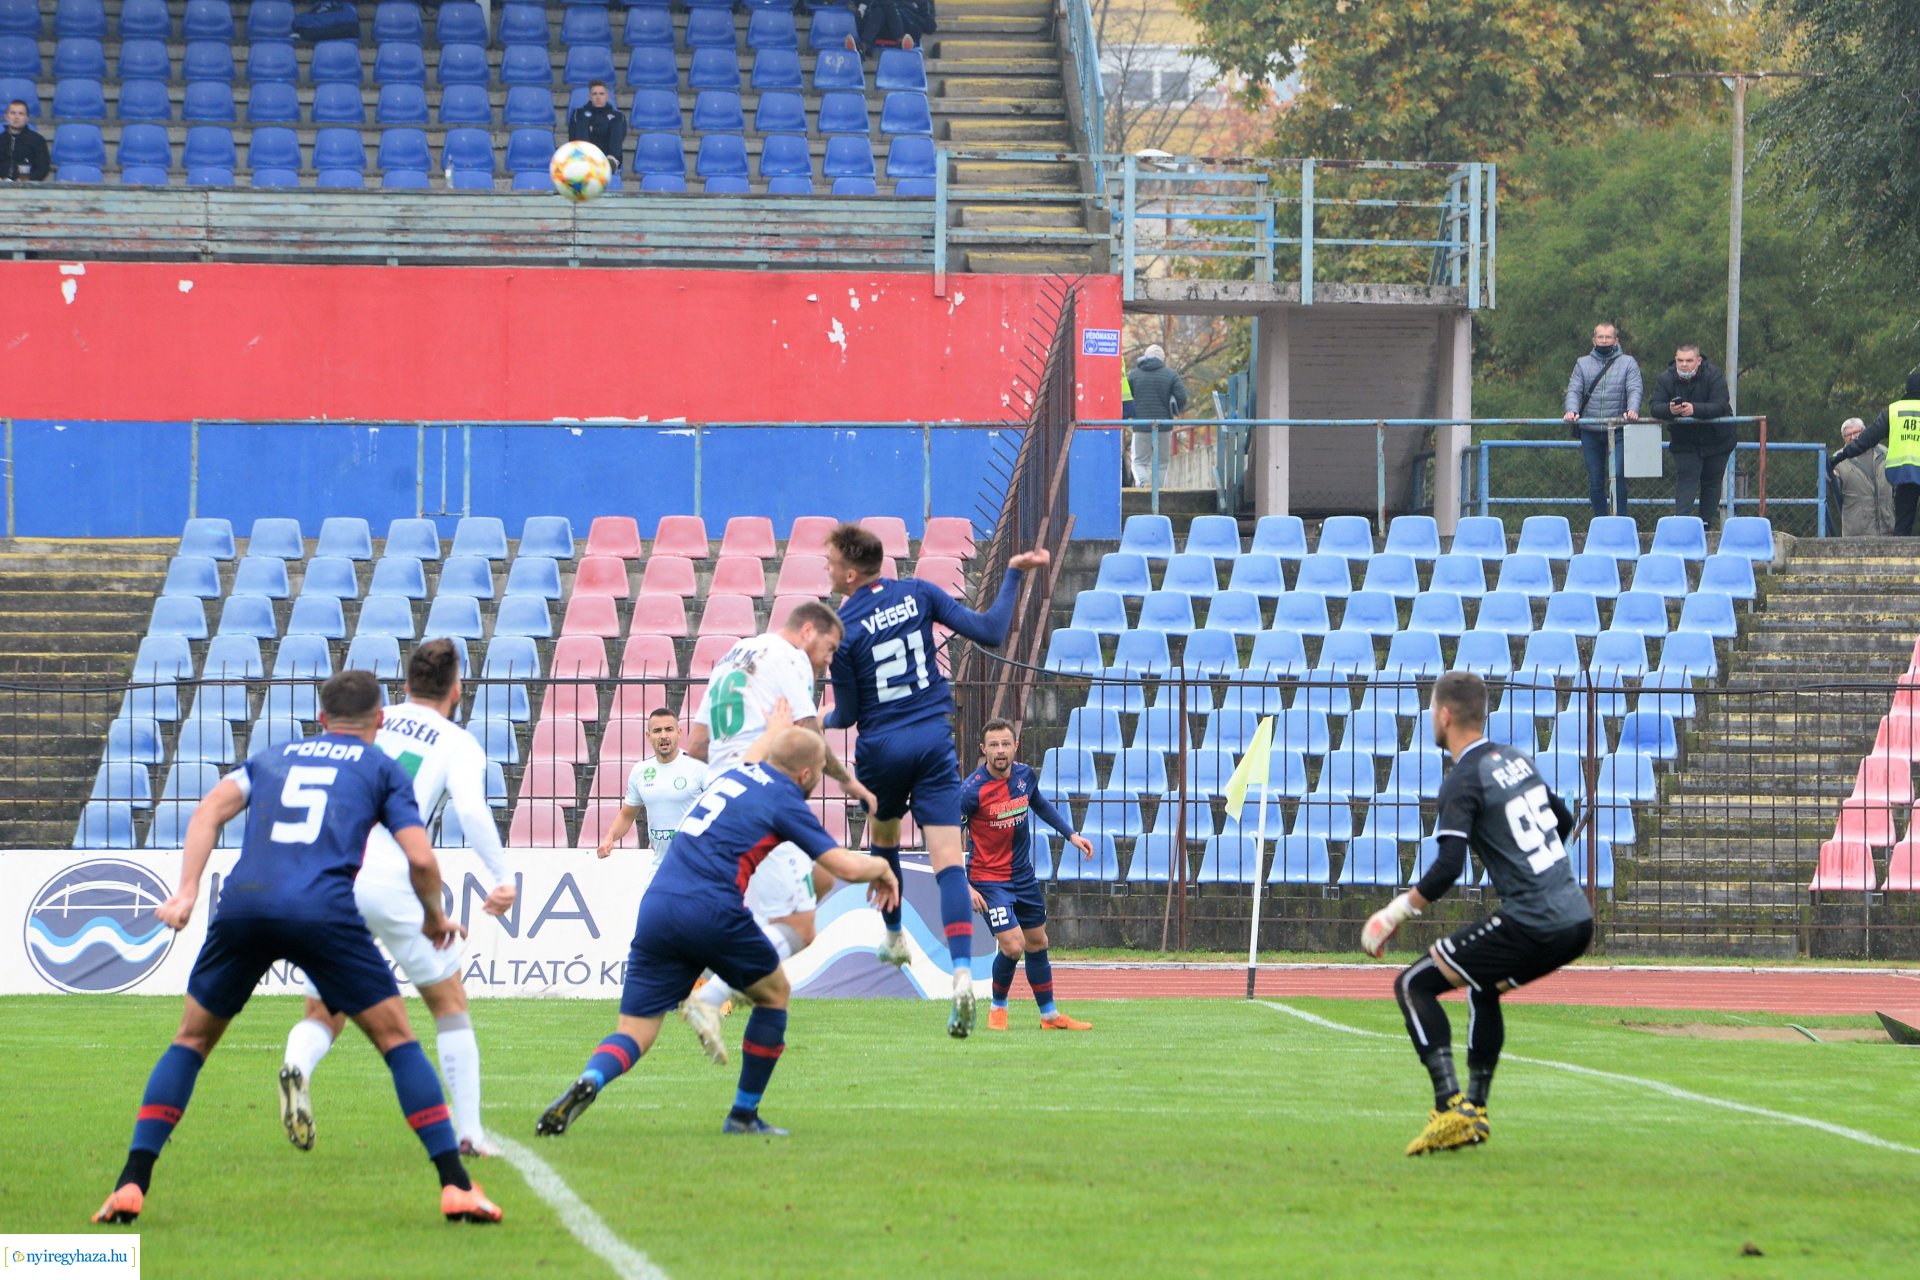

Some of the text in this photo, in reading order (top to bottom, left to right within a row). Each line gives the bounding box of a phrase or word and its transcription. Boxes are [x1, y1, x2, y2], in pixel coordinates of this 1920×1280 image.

[1903, 418, 1920, 431] 48
[871, 629, 930, 703] 21
[709, 670, 747, 740] 16
[283, 741, 364, 763] FODOR
[270, 765, 338, 845] 5
[1505, 784, 1567, 875] 95
[989, 906, 1009, 927] 22
